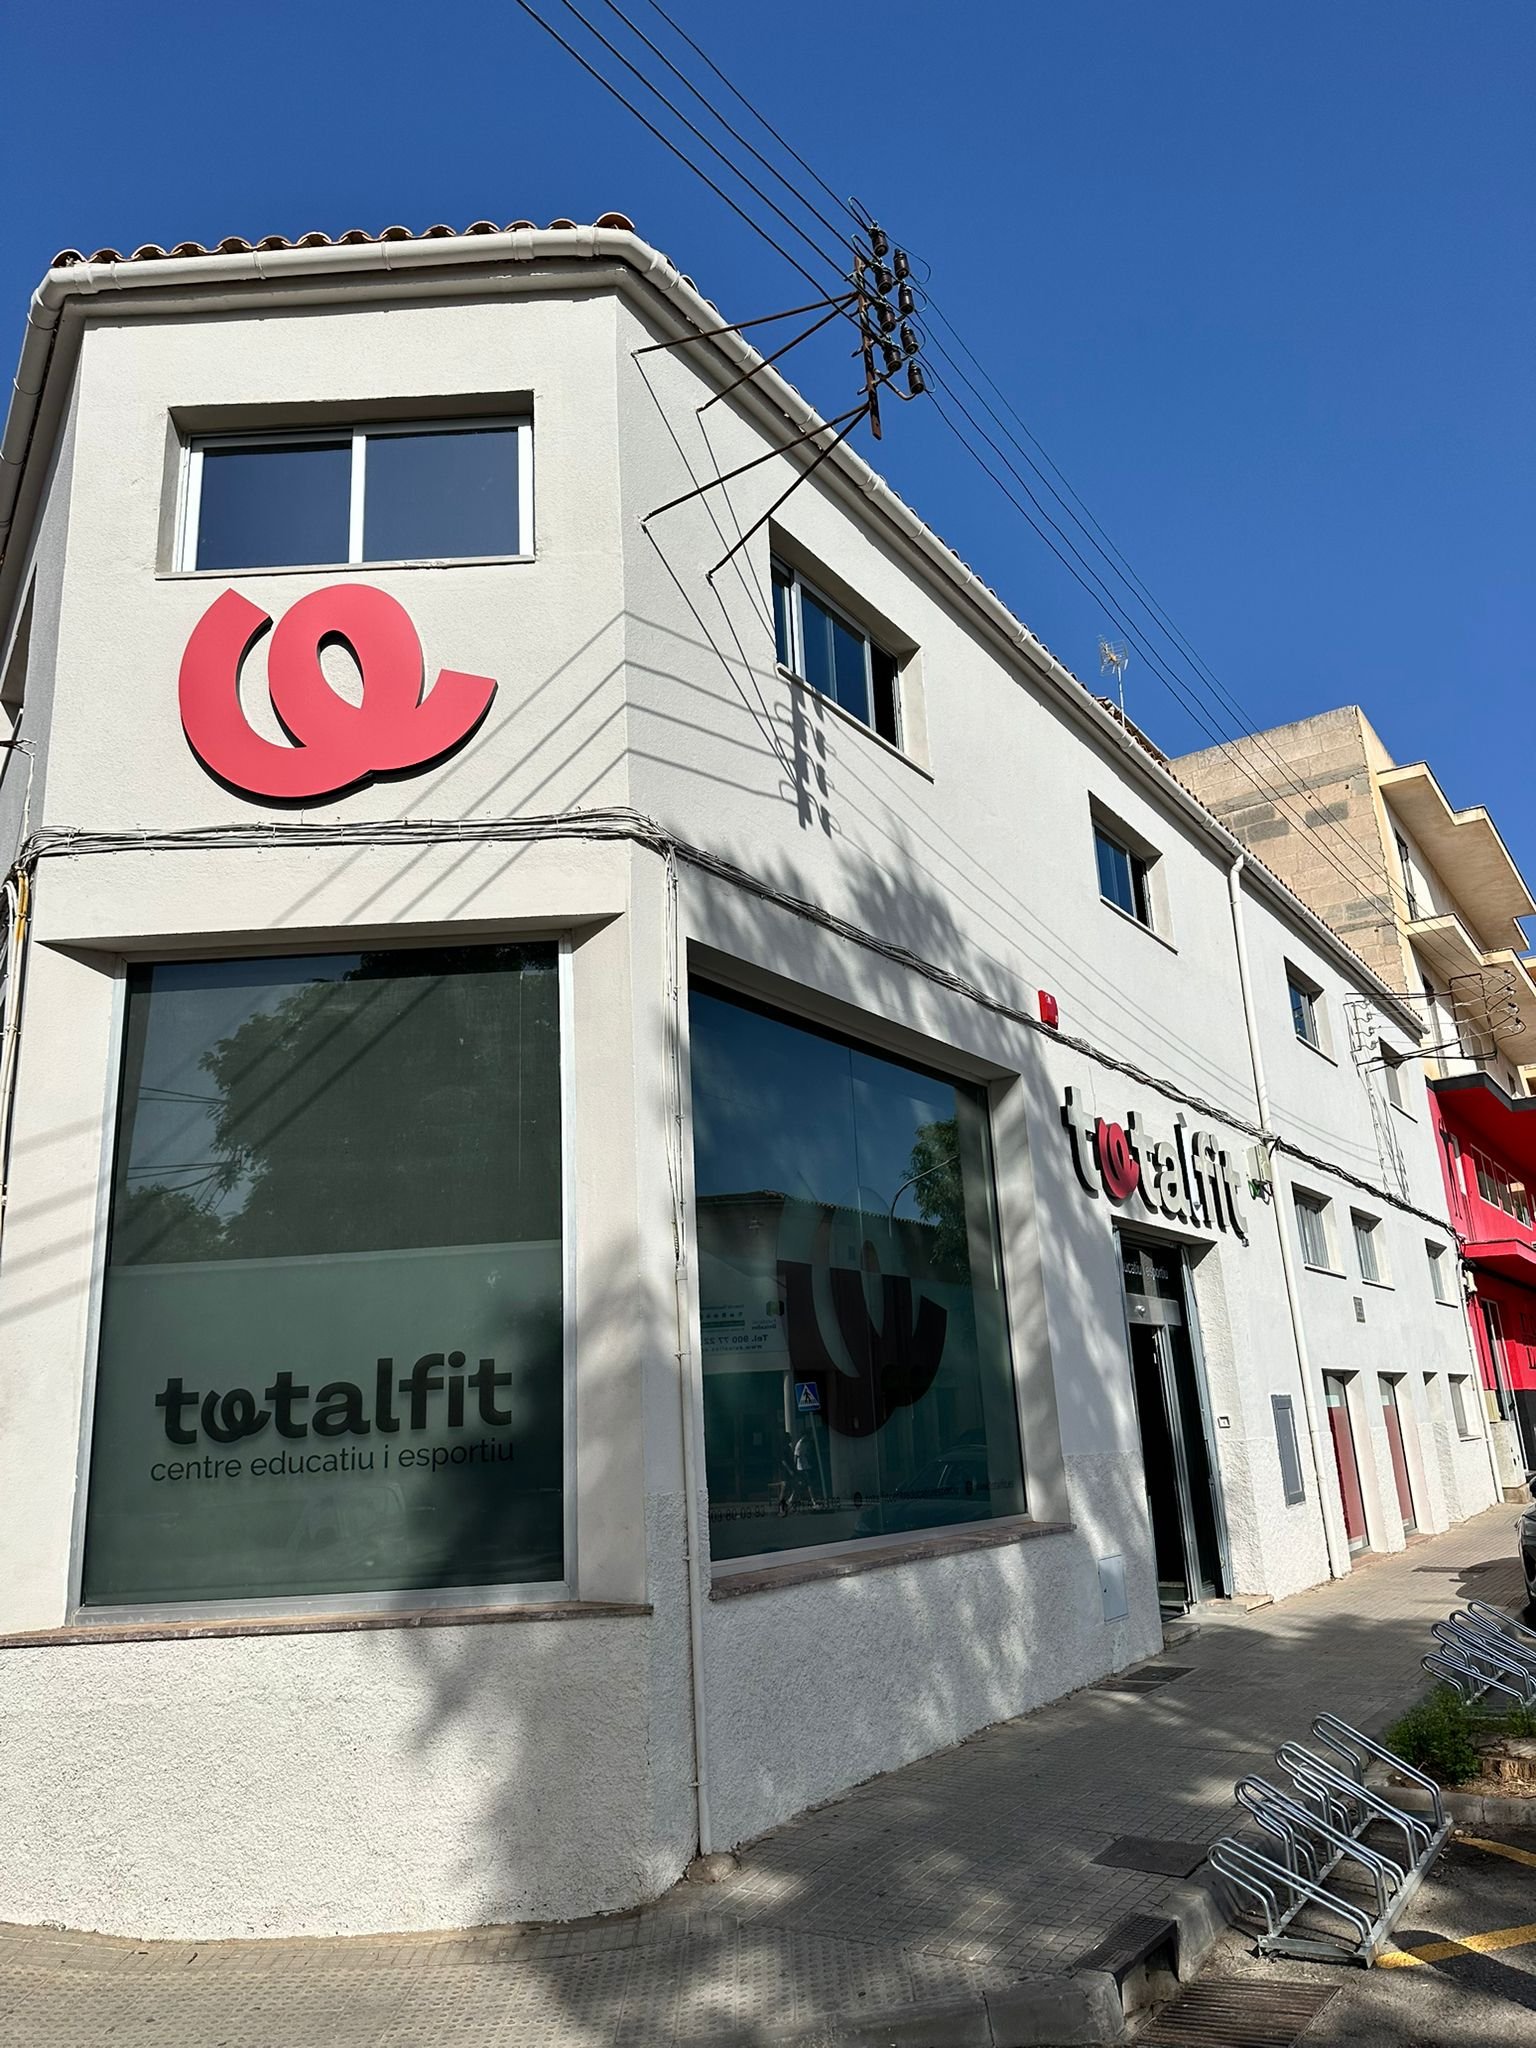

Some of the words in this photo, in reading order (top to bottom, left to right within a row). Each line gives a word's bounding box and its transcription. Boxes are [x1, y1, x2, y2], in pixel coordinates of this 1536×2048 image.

[1060, 1086, 1249, 1237] totalfit
[154, 1351, 513, 1445] totalfit
[150, 1454, 242, 1482] centre
[250, 1445, 374, 1478] educatiu
[383, 1444, 390, 1470] i
[400, 1438, 515, 1472] esportiu
